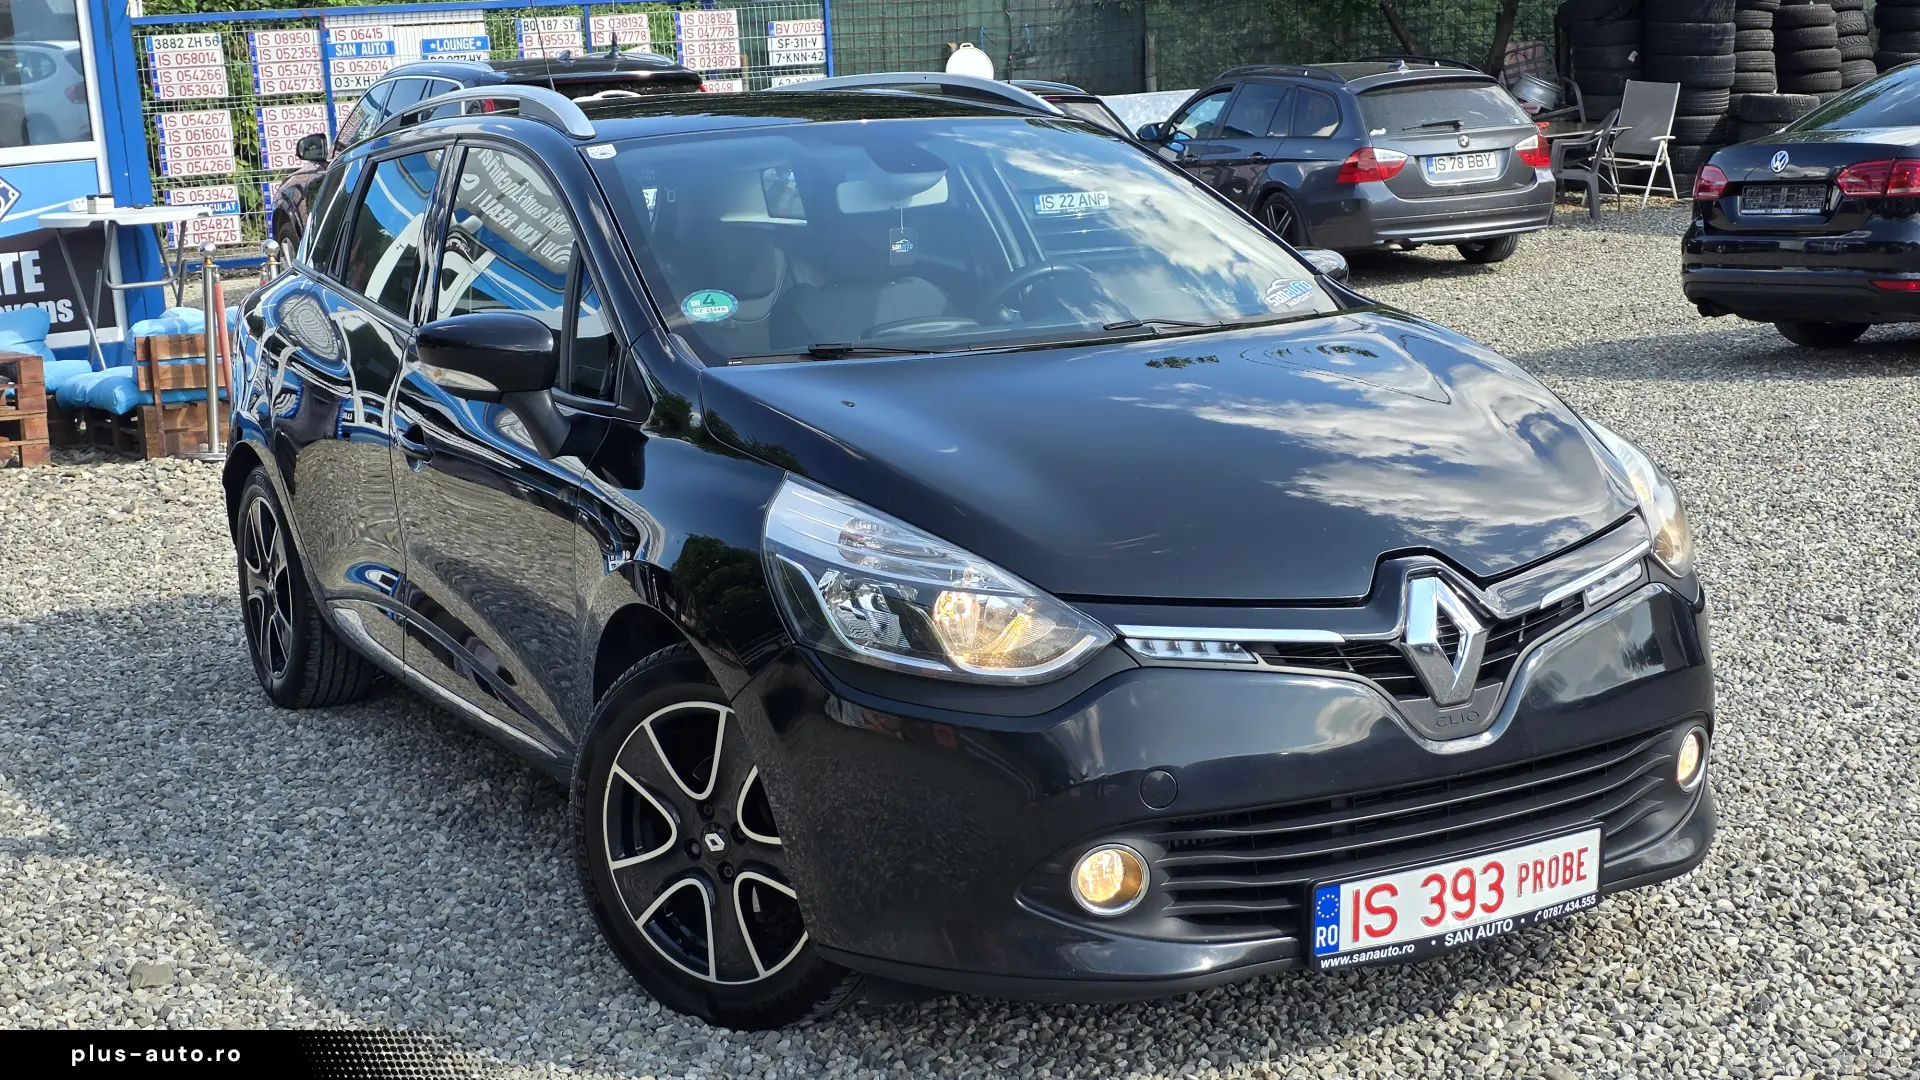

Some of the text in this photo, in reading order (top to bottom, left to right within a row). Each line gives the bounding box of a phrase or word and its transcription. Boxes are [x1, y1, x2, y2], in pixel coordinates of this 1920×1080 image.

[594, 16, 644, 30] IS 038192
[684, 12, 732, 25] IS 038192
[334, 28, 382, 41] IS 06415
[684, 26, 734, 39] IS 047778
[776, 22, 823, 34] BV 07039
[155, 35, 219, 49] 3882 ZH 56
[258, 32, 310, 46] IS 08950
[436, 38, 476, 51] LOUNGE
[525, 36, 533, 46] B
[594, 32, 605, 43] IS
[778, 37, 817, 48] SF-311-V
[260, 47, 318, 61] IS 052355
[335, 42, 387, 56] SAN AUTO
[685, 42, 736, 55] IS 052355
[159, 52, 216, 66] IS 058014
[686, 58, 696, 68] IS
[776, 52, 824, 63] 7-KNN-42
[261, 64, 320, 77] IS 053475
[333, 61, 388, 73] IS 052614
[160, 69, 221, 83] IS 054266
[162, 84, 223, 97] IS 053943
[263, 78, 322, 92] IS 045733
[165, 112, 225, 127] IS 054267
[265, 107, 324, 121] IS 053943
[169, 128, 226, 142] IS 061604
[267, 125, 279, 137] IS
[284, 122, 326, 136] 054260
[170, 144, 227, 158] IS 061604
[269, 140, 281, 152] IS
[170, 160, 231, 174] IS 054266
[271, 155, 283, 167] IS
[1434, 154, 1491, 171] IS 78 BBY
[173, 188, 234, 203] IS 053942
[1042, 193, 1105, 209] IS 22 ANP
[193, 218, 234, 231] 054821
[193, 230, 236, 244] 056426
[0, 250, 44, 296] TE
[703, 294, 716, 306] 4
[1436, 710, 1480, 728] CLIO
[1352, 846, 1589, 943] IS 393 PROBE
[1316, 923, 1339, 948] RO
[1320, 944, 1415, 969] www.sanauto.ro
[1444, 929, 1473, 947] SAN
[1476, 919, 1513, 940] AUTO
[1543, 895, 1596, 919] 0787.434.555
